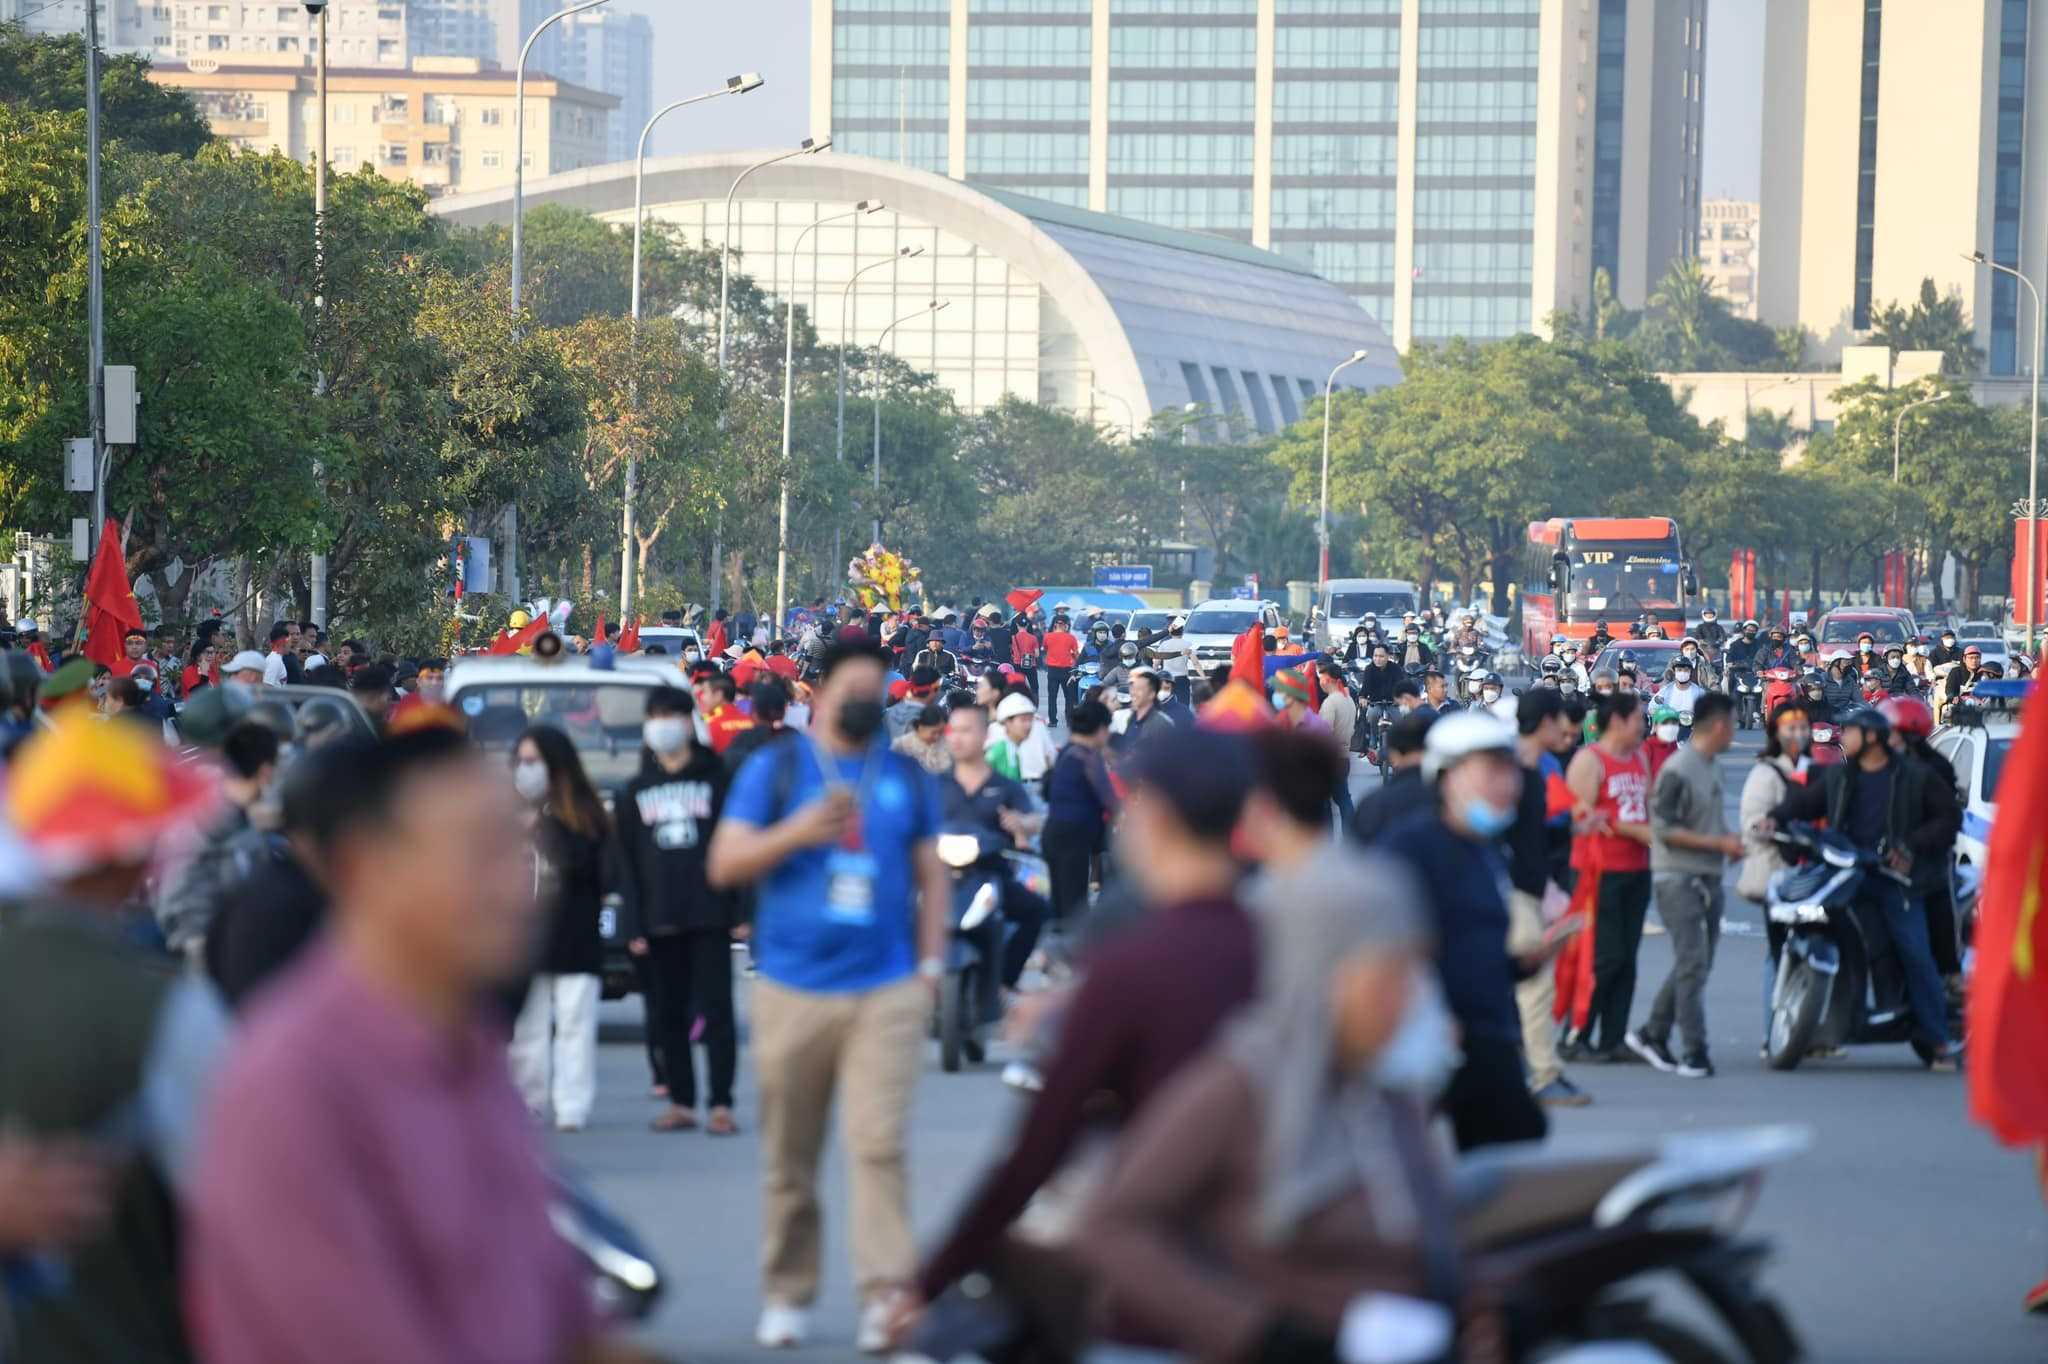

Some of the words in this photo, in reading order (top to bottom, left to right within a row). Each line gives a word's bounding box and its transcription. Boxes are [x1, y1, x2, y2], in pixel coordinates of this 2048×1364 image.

[190, 59, 217, 68] HUD
[1582, 551, 1614, 565] VIP
[1626, 555, 1672, 566] Limousine
[1617, 794, 1647, 821] 23
